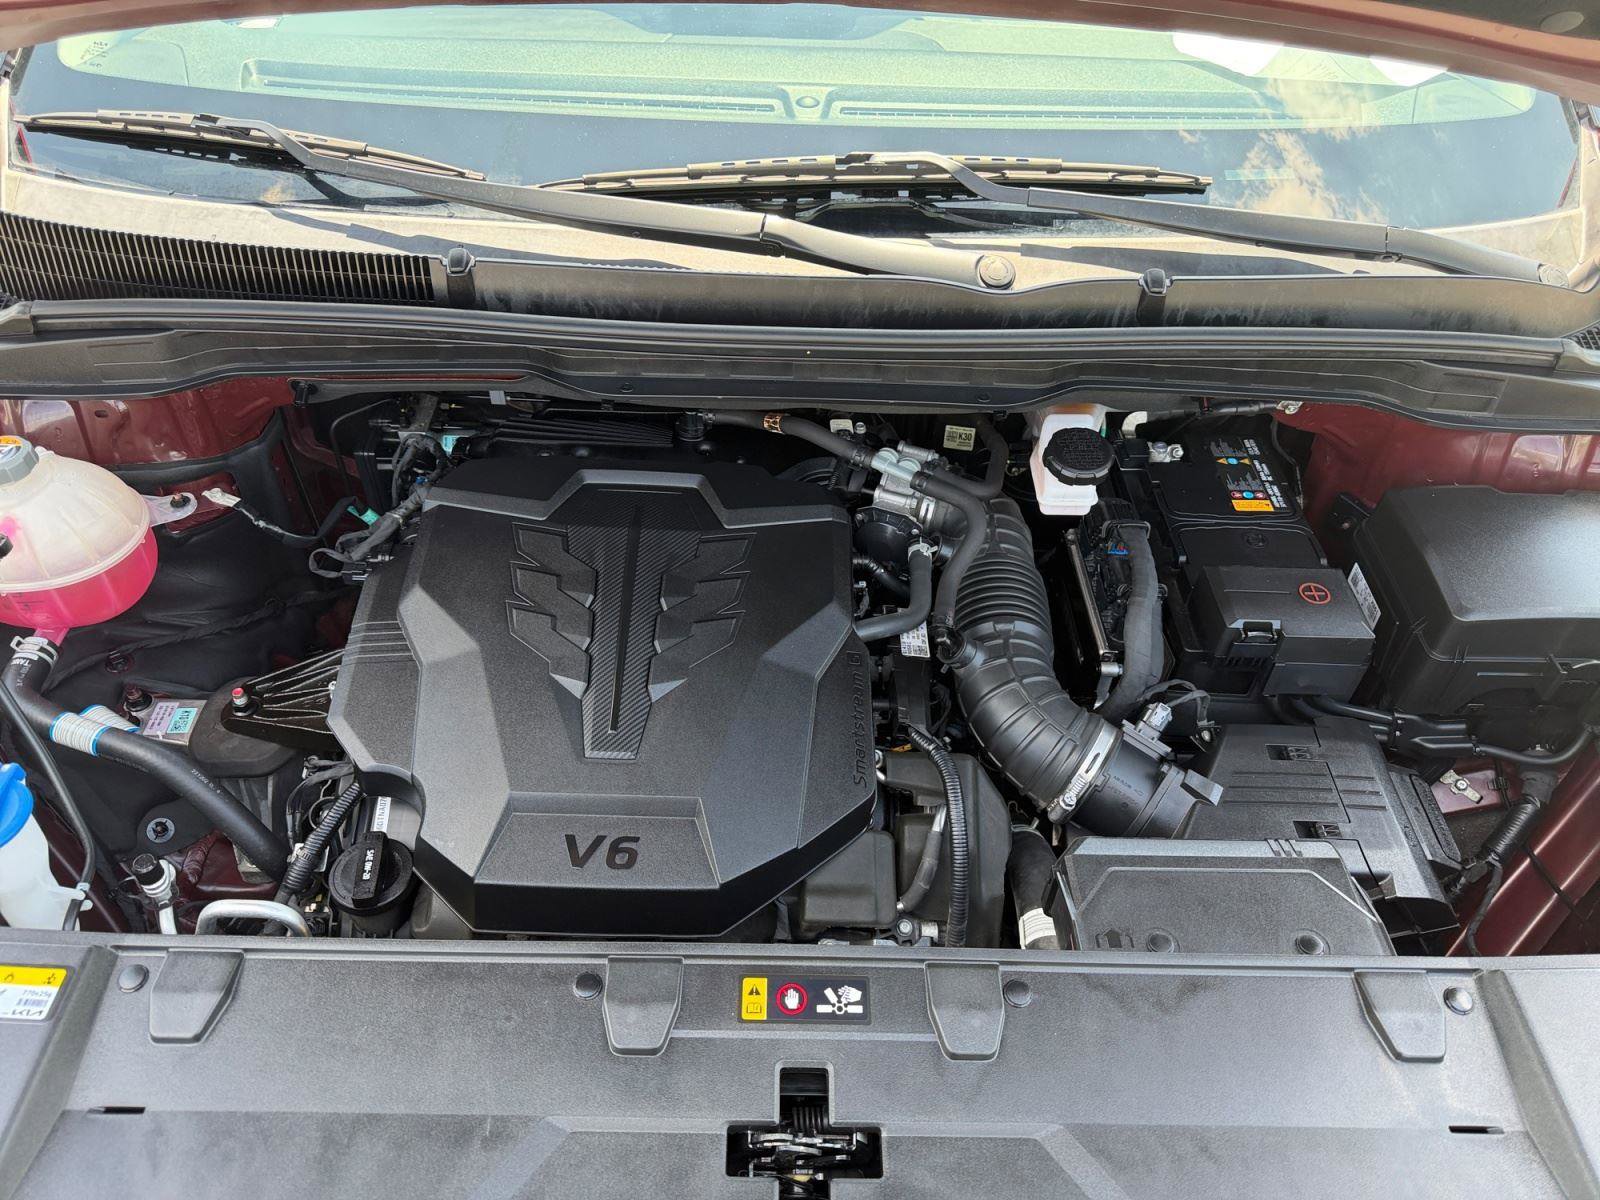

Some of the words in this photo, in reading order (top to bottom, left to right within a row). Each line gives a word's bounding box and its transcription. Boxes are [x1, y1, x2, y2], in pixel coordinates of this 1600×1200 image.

[958, 431, 973, 441] K30
[850, 670, 868, 788] Smartstream
[365, 849, 375, 861] SAE
[565, 834, 640, 869] V6
[12, 1009, 44, 1017] KIA
